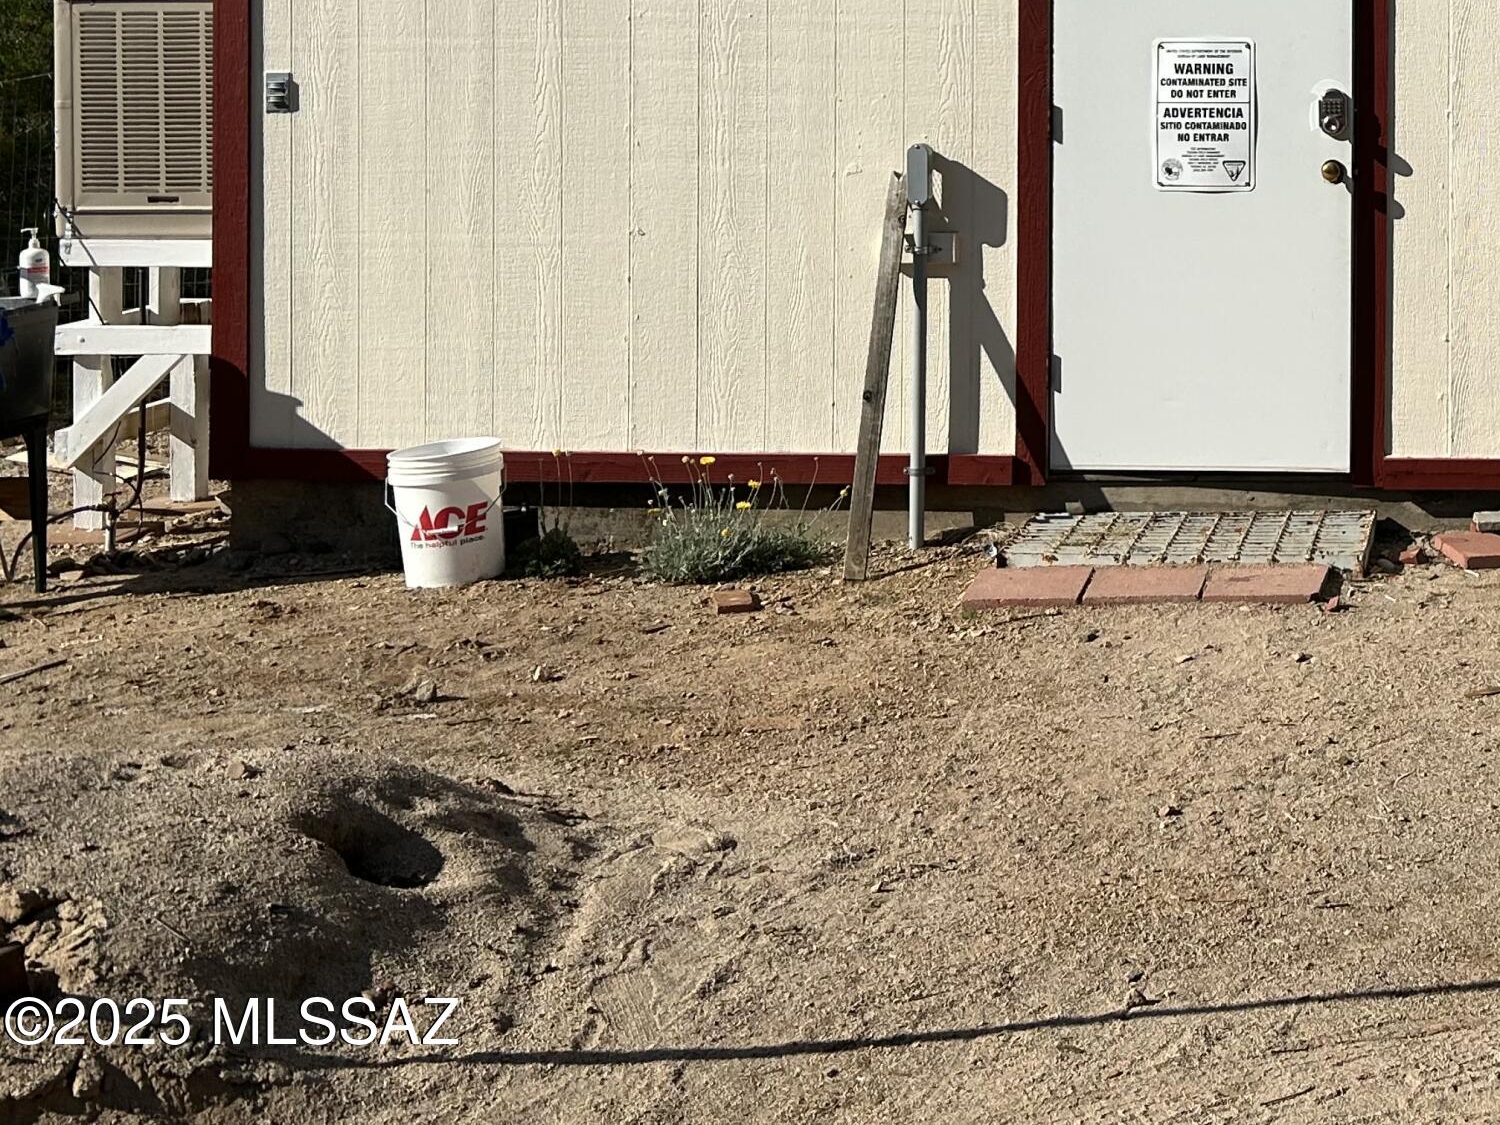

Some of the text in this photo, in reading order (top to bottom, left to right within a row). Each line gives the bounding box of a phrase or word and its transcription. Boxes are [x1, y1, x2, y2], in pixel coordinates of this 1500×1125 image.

[1174, 63, 1234, 75] WARNING
[1160, 78, 1248, 87] CONTAMINATED SITE
[1170, 89, 1237, 98] DO NOT ENTER
[1163, 107, 1244, 118] ADVERTENCIA
[1160, 122, 1247, 130] SITIO CONTAMINADO
[1177, 133, 1230, 142] NO ENTRAR
[410, 501, 488, 541] ACE
